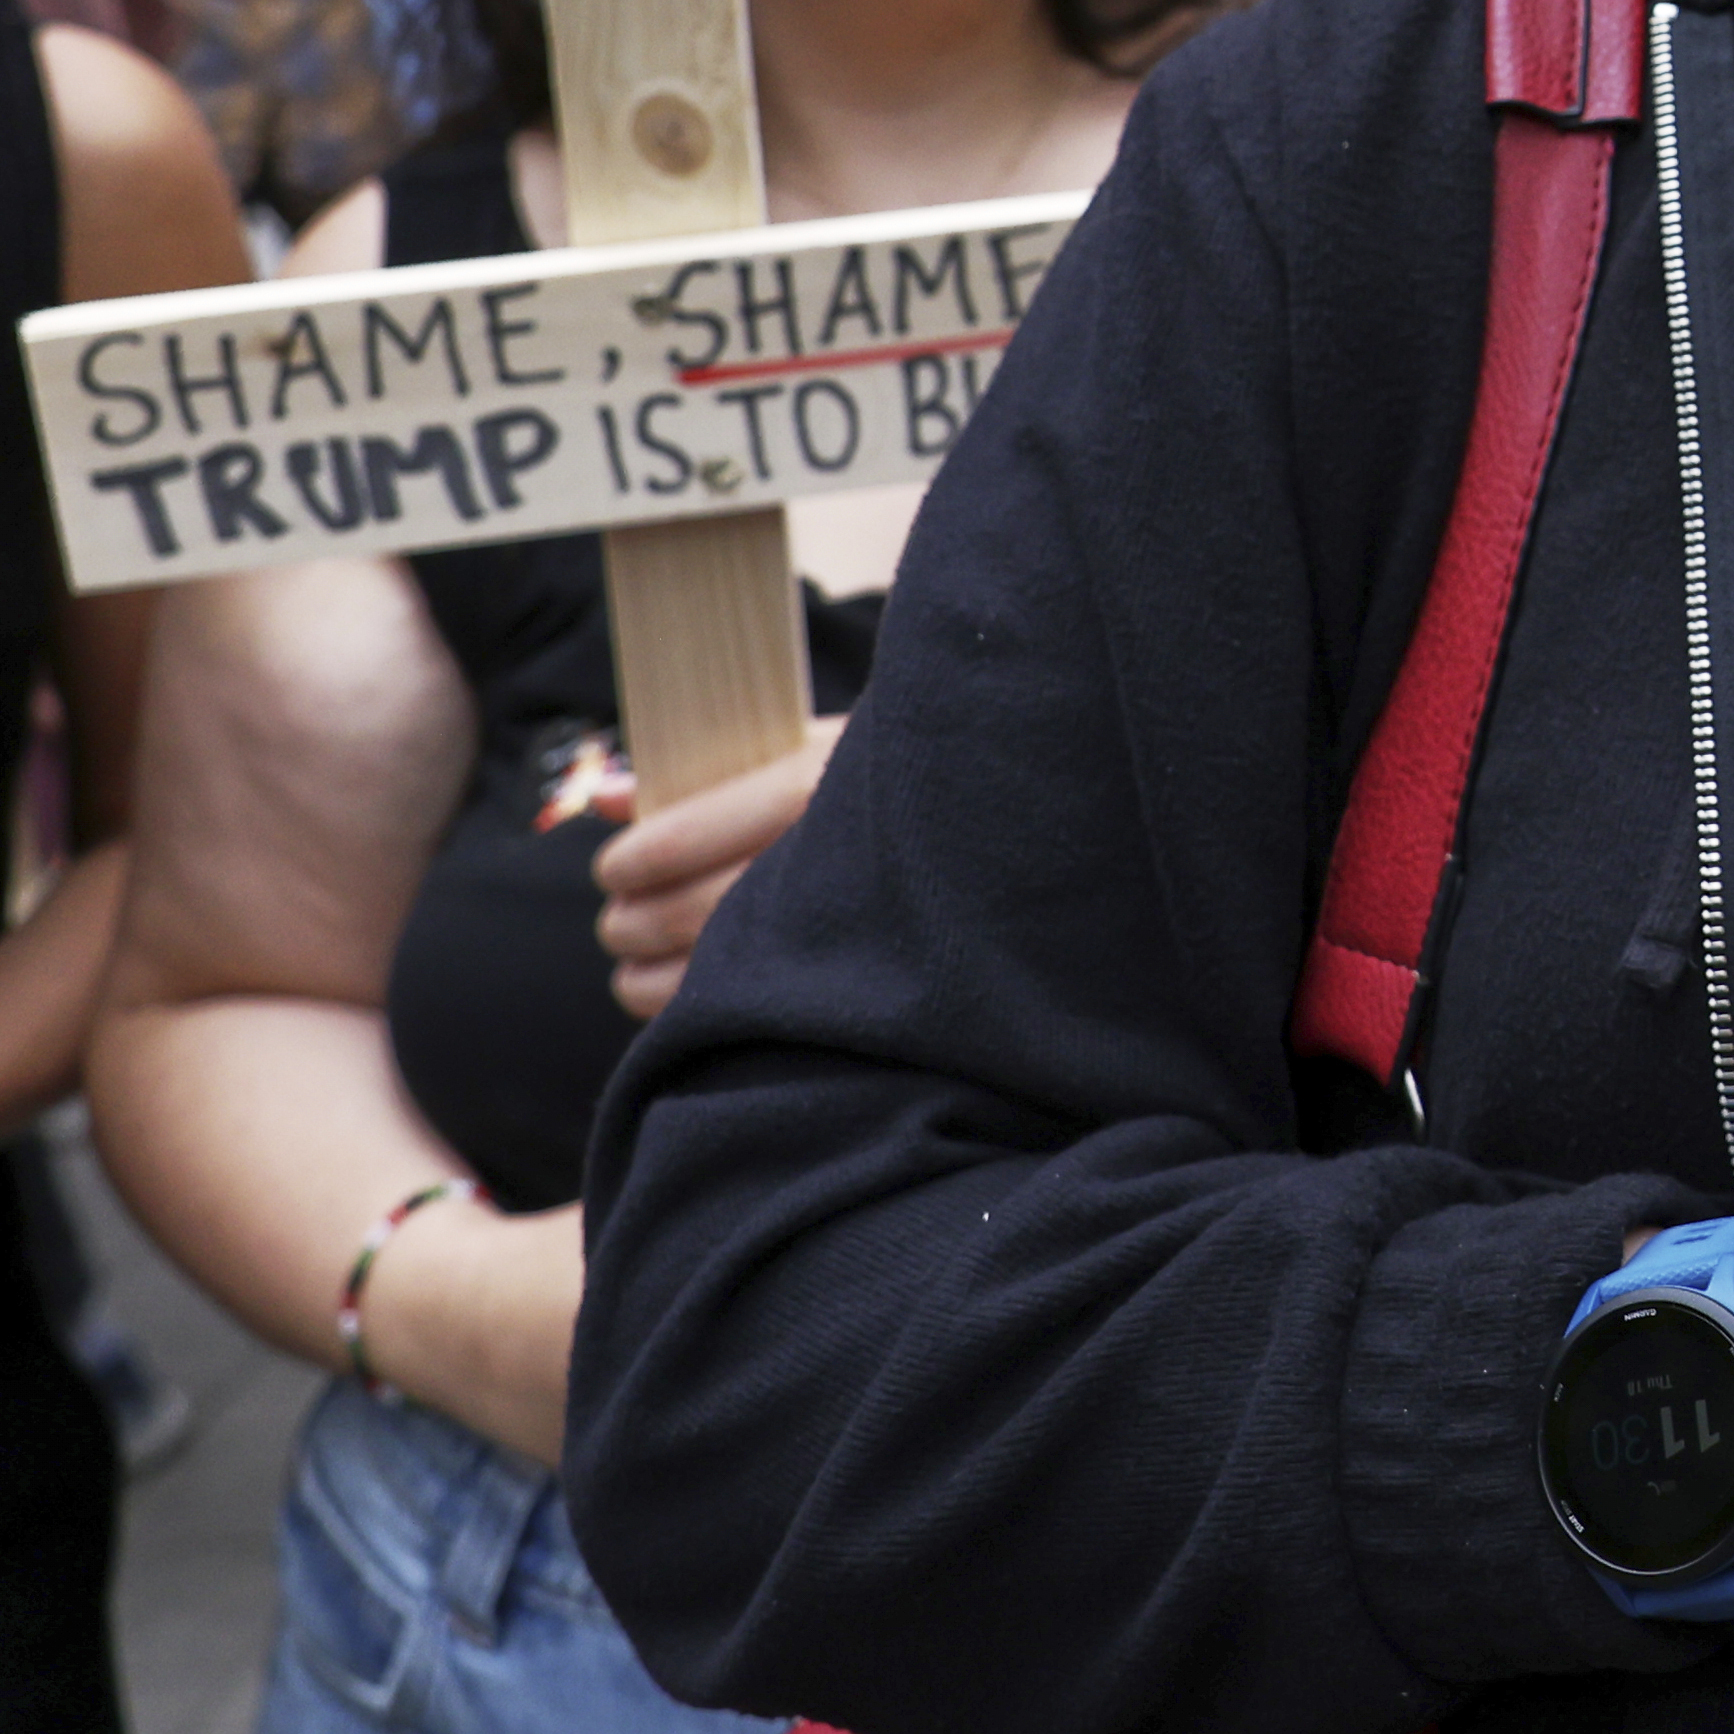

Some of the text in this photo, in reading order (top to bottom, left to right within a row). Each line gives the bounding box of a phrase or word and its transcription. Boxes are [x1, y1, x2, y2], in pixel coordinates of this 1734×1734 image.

[663, 222, 1050, 373] SHAME
[91, 405, 559, 559] TRUMP
[597, 394, 693, 495] IS
[716, 378, 860, 480] TO
[1623, 1307, 1658, 1322] GARMIN
[1647, 1373, 1673, 1391] Thu
